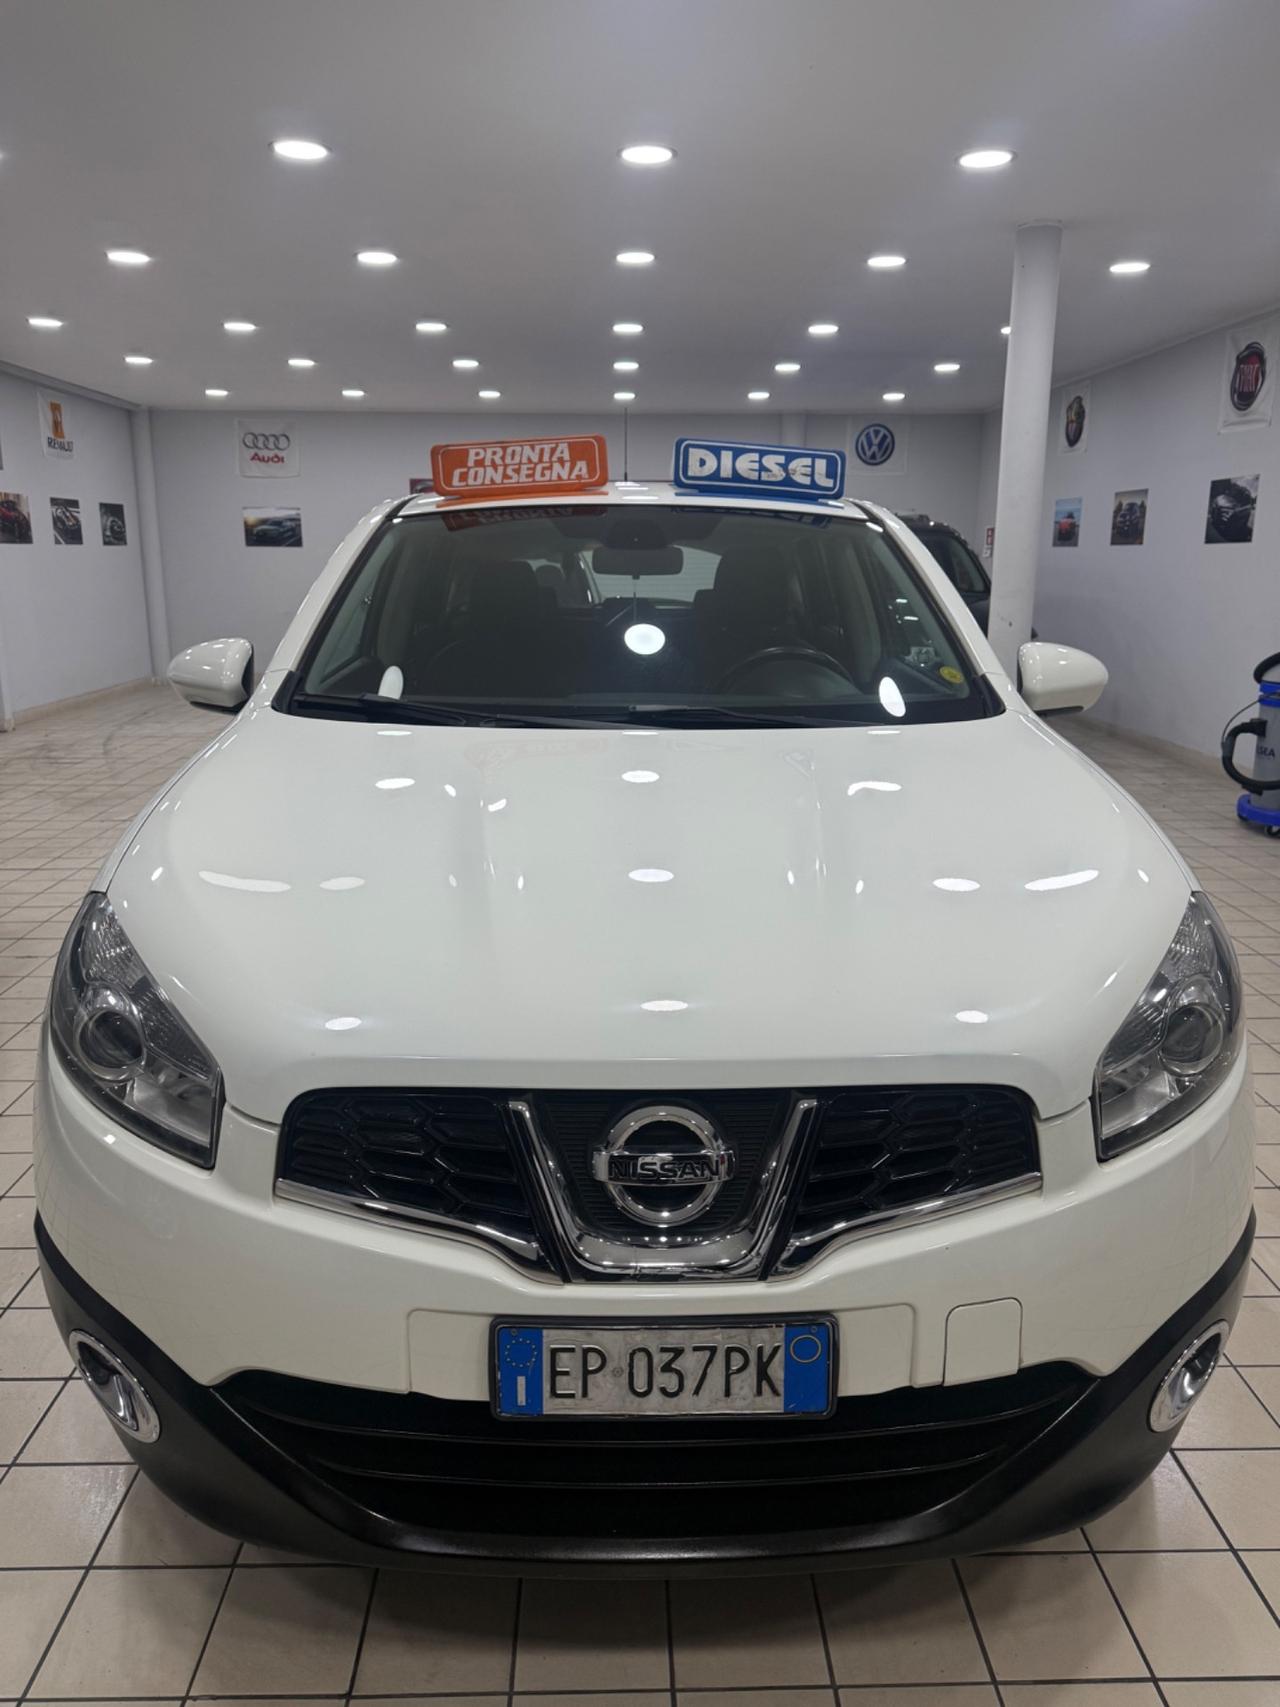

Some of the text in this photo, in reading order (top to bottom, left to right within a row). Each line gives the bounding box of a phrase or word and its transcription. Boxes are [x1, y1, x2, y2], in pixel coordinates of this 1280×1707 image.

[250, 452, 285, 464] Audi
[467, 442, 570, 467] PRONTA
[687, 447, 834, 487] DIESEL
[452, 460, 589, 487] CONSEGNA
[608, 1158, 720, 1179] NISSAN
[550, 1345, 607, 1399] EP
